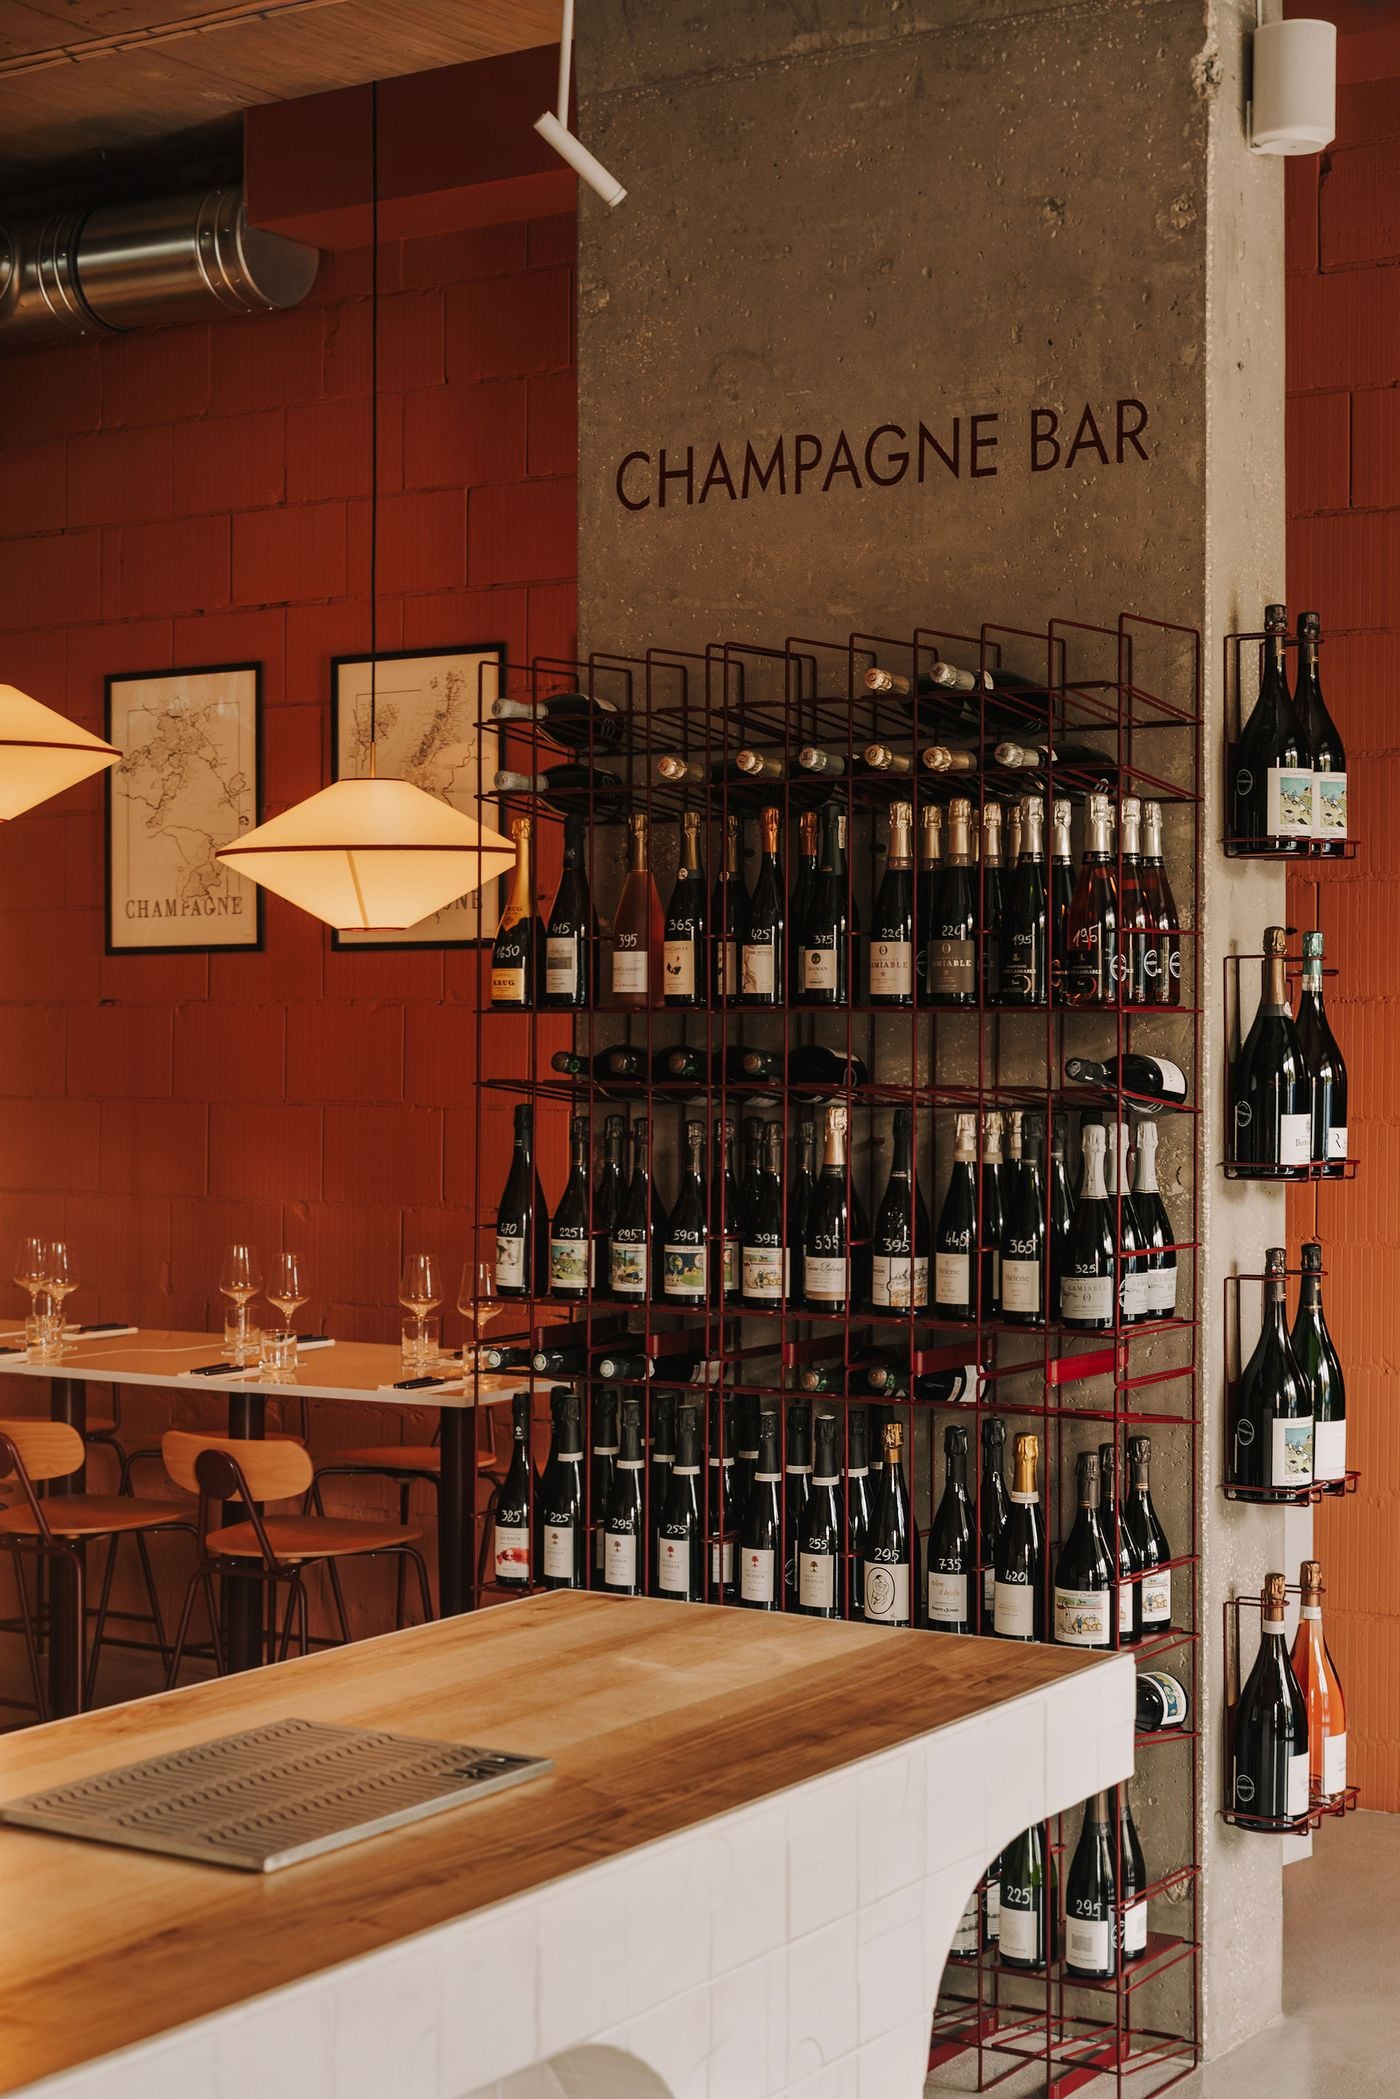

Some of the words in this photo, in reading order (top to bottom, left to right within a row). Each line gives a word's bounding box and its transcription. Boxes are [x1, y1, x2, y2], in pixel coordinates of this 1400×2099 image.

[615, 411, 999, 510] CHAMPAGNE
[1030, 399, 1149, 473] BAR
[125, 896, 243, 919] CHAMPAGNE
[553, 922, 571, 935] 415
[668, 918, 694, 931] 365
[941, 925, 962, 937] 220
[751, 928, 771, 940] 425
[881, 928, 903, 938] 220
[1072, 924, 1100, 947] 195
[619, 933, 638, 948] 395
[814, 935, 835, 945] 375
[1012, 934, 1034, 946] 195
[871, 961, 908, 969] AMIABLE
[932, 959, 973, 968] AMIABLE
[560, 1227, 579, 1239] 225
[618, 1229, 641, 1242] 295
[945, 1231, 970, 1247] 445
[815, 1234, 840, 1250] 535
[883, 1238, 911, 1253] 395
[1009, 1239, 1038, 1254] 365
[1075, 1264, 1097, 1274] 325
[501, 1510, 522, 1523] 385
[550, 1512, 571, 1523] 225
[612, 1518, 634, 1529] 295
[666, 1524, 689, 1535] 255
[809, 1538, 828, 1550] 255
[874, 1548, 900, 1561] 295
[939, 1558, 962, 1571] 735
[1005, 1569, 1026, 1582] 420
[1006, 1885, 1030, 1904] 225
[1076, 1899, 1102, 1917] 295
